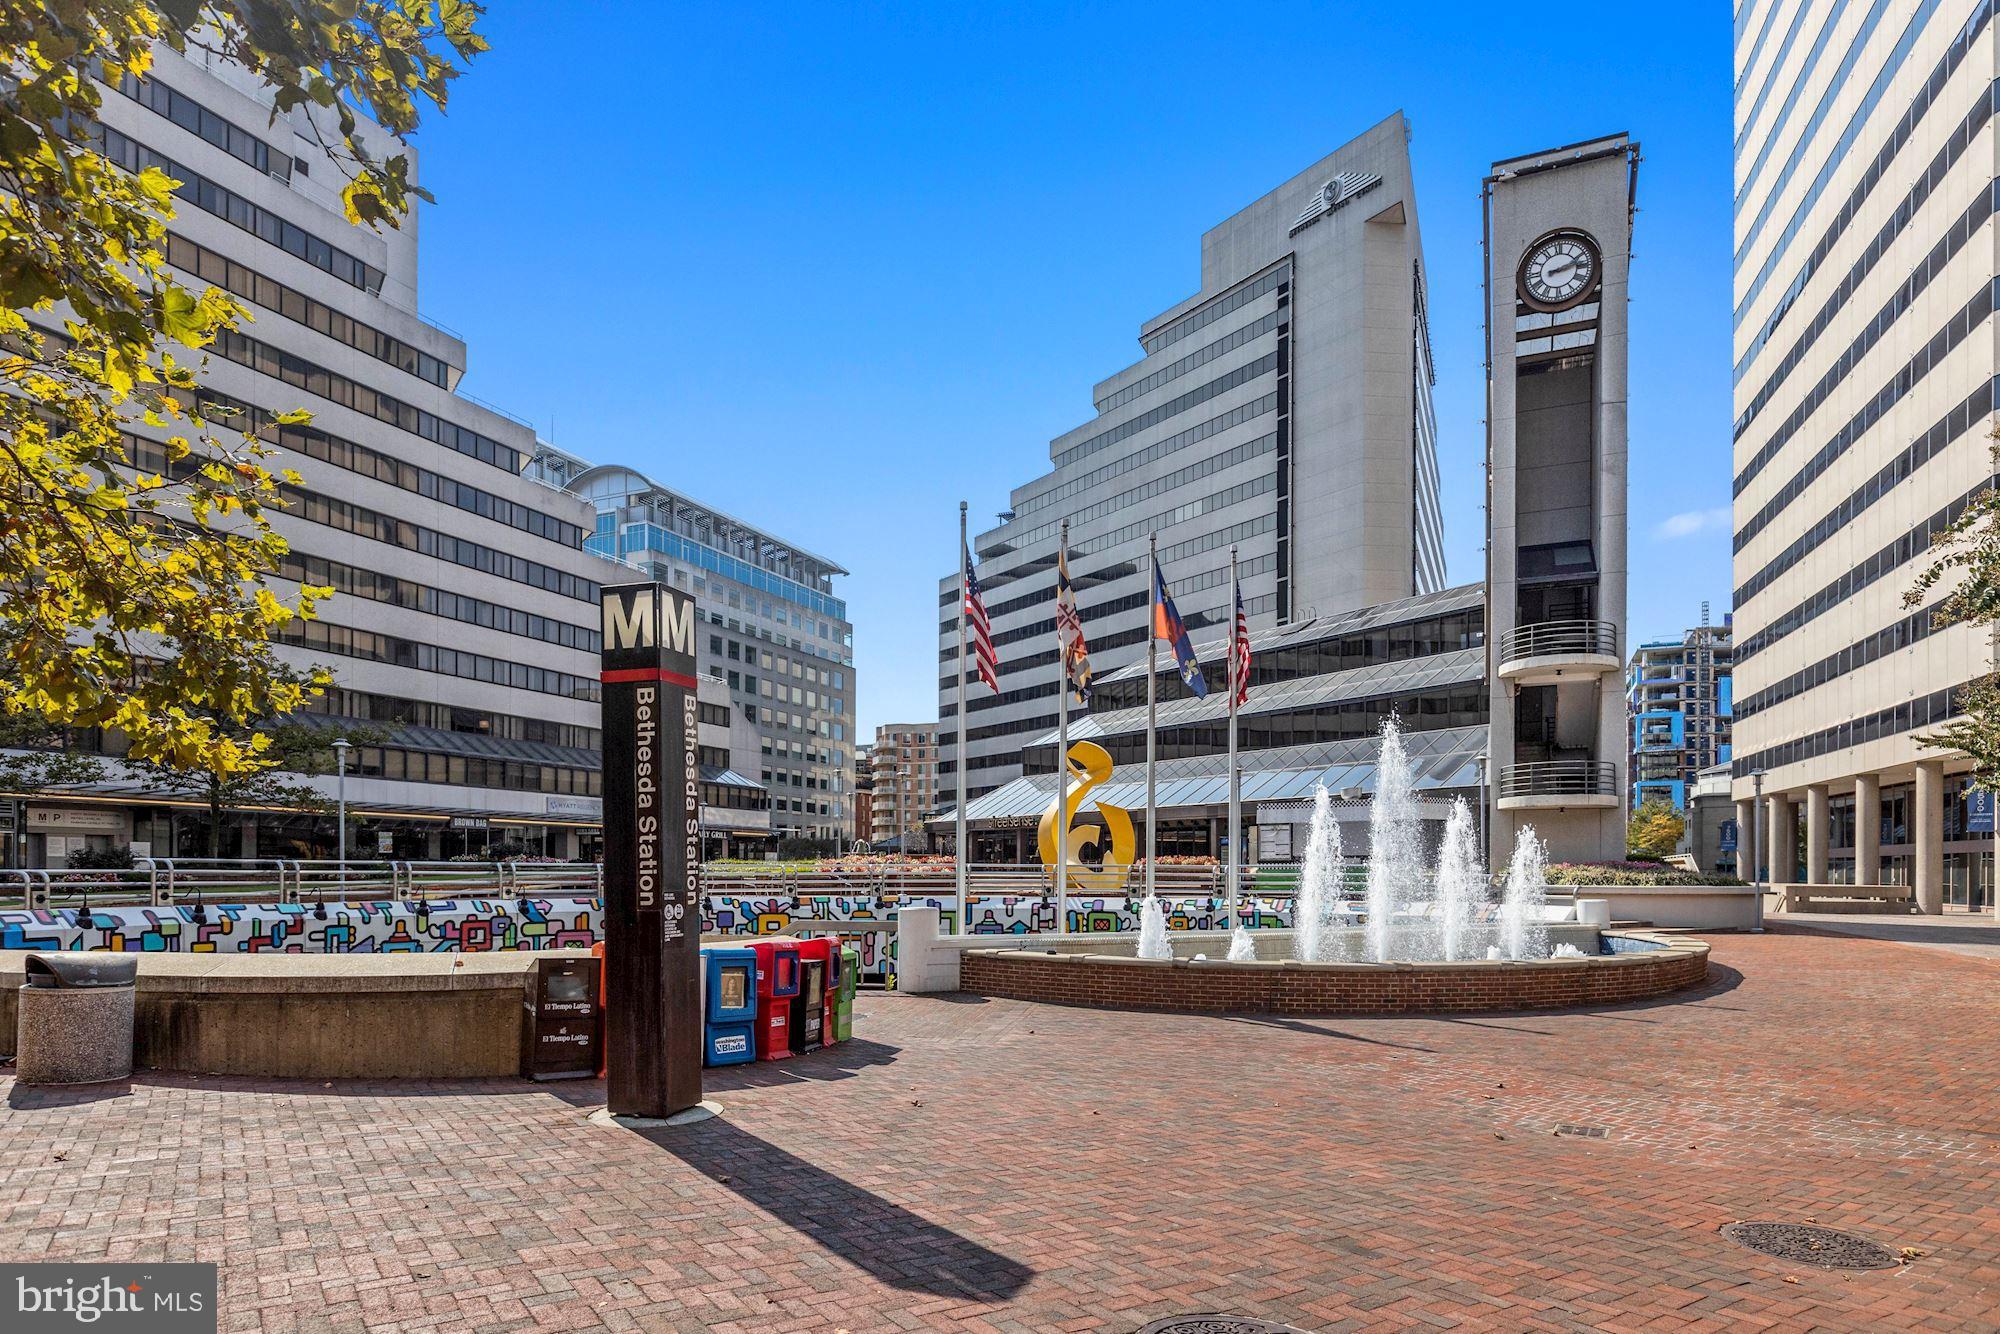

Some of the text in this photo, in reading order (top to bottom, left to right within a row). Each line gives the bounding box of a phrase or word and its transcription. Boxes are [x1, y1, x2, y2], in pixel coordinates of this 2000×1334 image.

[603, 590, 653, 650] M
[662, 590, 695, 657] M
[637, 687, 657, 906] Bethesda Station
[684, 694, 698, 905] Bethesda Station
[38, 813, 47, 821] M
[53, 813, 61, 821] P
[454, 817, 487, 828] BROWN BAG
[711, 830, 728, 839] GRILL
[551, 1002, 572, 1011] Tiempo
[573, 1002, 591, 1010] Latino
[549, 1034, 570, 1042] Tiempo
[571, 1033, 589, 1041] Latino
[722, 1042, 745, 1054] Blade
